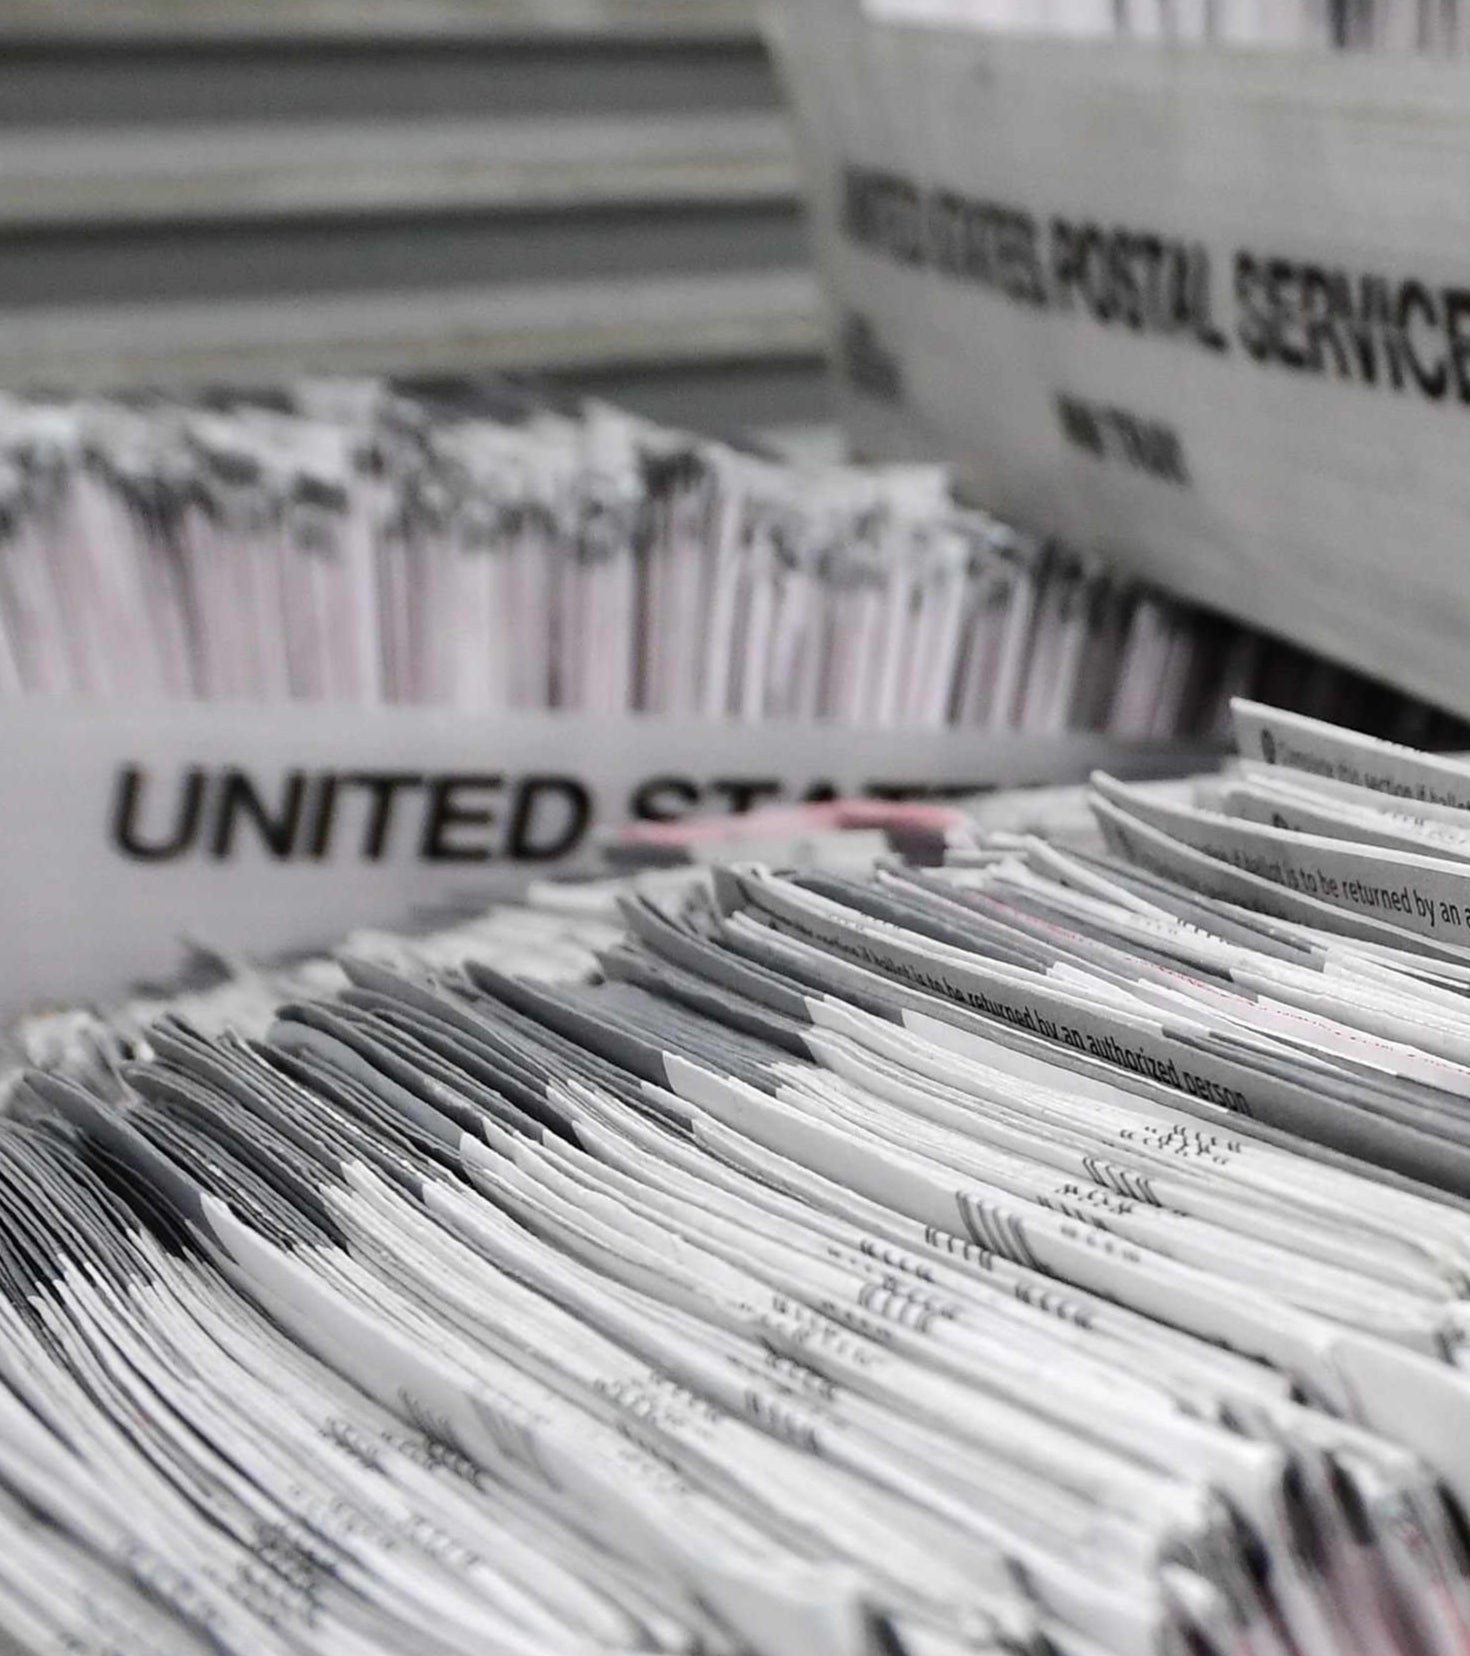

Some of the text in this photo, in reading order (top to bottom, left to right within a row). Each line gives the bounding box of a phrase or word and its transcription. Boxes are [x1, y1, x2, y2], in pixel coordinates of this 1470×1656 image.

[1051, 219, 1228, 354] POSTAL
[111, 762, 594, 863] UNITED
[1301, 869, 1319, 893] to
[1318, 868, 1339, 899] be
[1342, 879, 1412, 914] returned
[1413, 889, 1436, 928] by
[1439, 900, 1462, 926] an
[968, 991, 1038, 1032] returned
[1034, 1008, 1059, 1040] by
[1062, 1024, 1085, 1050] an
[1086, 1033, 1186, 1091] authorized
[1182, 1070, 1252, 1116] person
